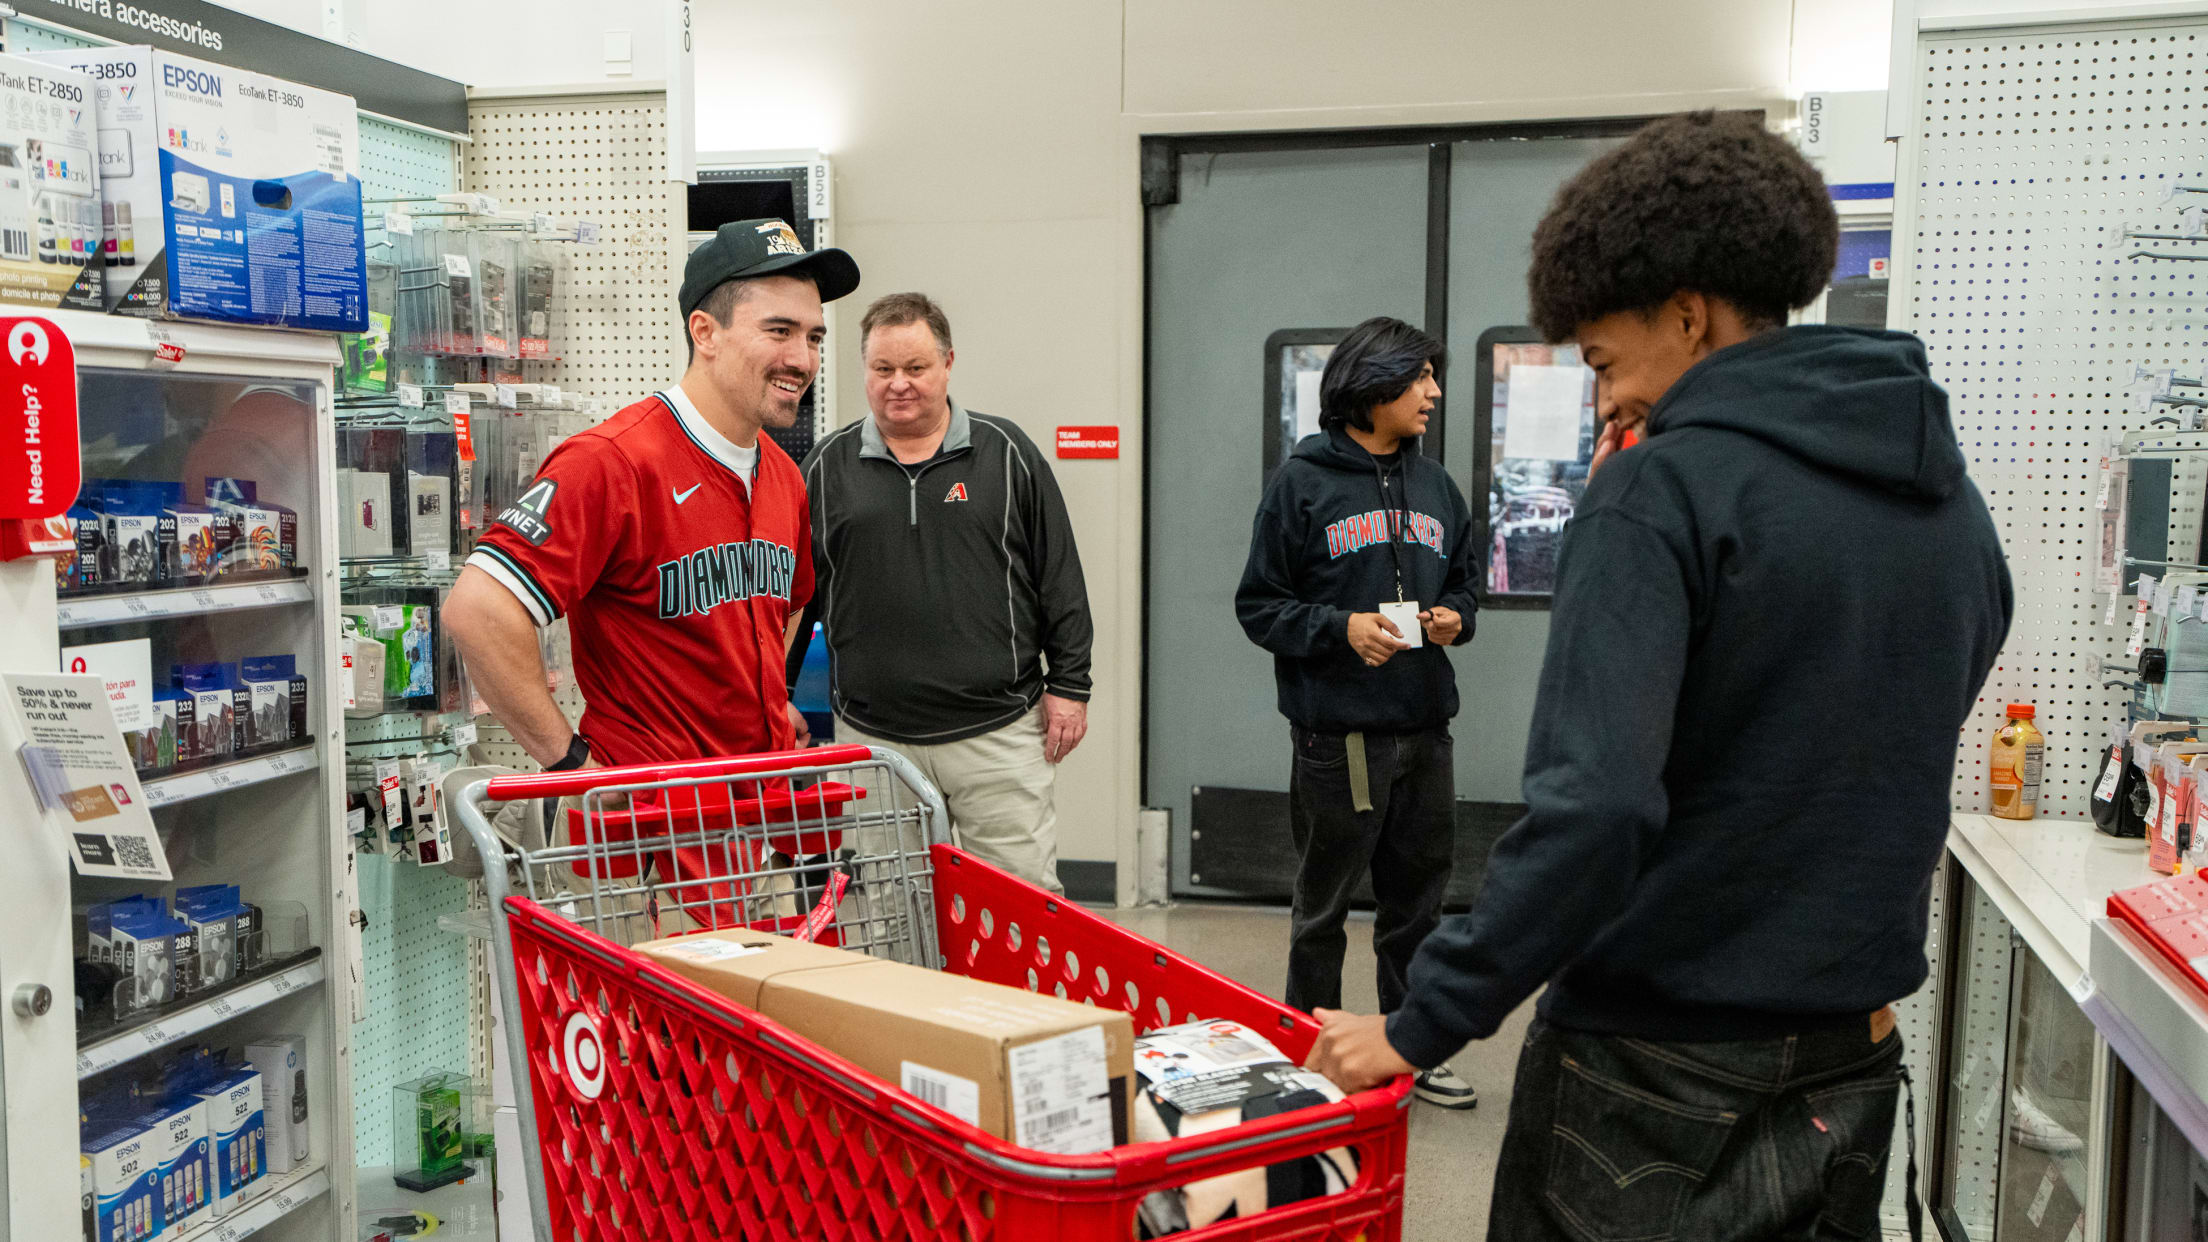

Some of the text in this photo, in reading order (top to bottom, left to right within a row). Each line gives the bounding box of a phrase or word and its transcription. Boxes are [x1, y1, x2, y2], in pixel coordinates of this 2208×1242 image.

[116, 3, 223, 51] accessories
[163, 63, 223, 98] EPSON
[28, 75, 83, 103] ET-2850
[238, 84, 304, 109] EcoTank ET-3850
[1808, 97, 1823, 144] B53
[815, 165, 825, 206] B52
[22, 274, 48, 287] printing
[2, 288, 61, 302] domicile et photo
[156, 344, 178, 360] Sale!
[22, 383, 42, 445] Help?
[1058, 431, 1081, 439] TEAM
[1058, 440, 1117, 448] MEMBERS ONLY
[28, 448, 45, 505] Need
[121, 519, 142, 528] EPSON
[180, 516, 200, 524] EPSON
[216, 517, 230, 527] 202
[249, 512, 267, 521] EPSON
[159, 518, 176, 530] 202
[81, 553, 96, 565] 202
[657, 538, 796, 620] DIAMONDBA
[17, 686, 77, 700] Save up to
[256, 684, 275, 693] EPSON
[291, 681, 305, 692] 232
[21, 698, 93, 711] 50% & never
[200, 694, 219, 703] EPSON
[177, 700, 193, 712] 232
[26, 711, 68, 721] run out
[146, 790, 165, 800] 43.99
[203, 922, 227, 936] EPSON
[237, 917, 250, 929] 288
[140, 940, 164, 954] EPSON
[175, 935, 191, 949] 288
[230, 1084, 250, 1101] EPSON
[235, 1102, 248, 1116] 522
[169, 1113, 191, 1131] EPSON
[174, 1128, 189, 1143] 522
[116, 1141, 141, 1159] EPSON
[121, 1160, 138, 1176] 502
